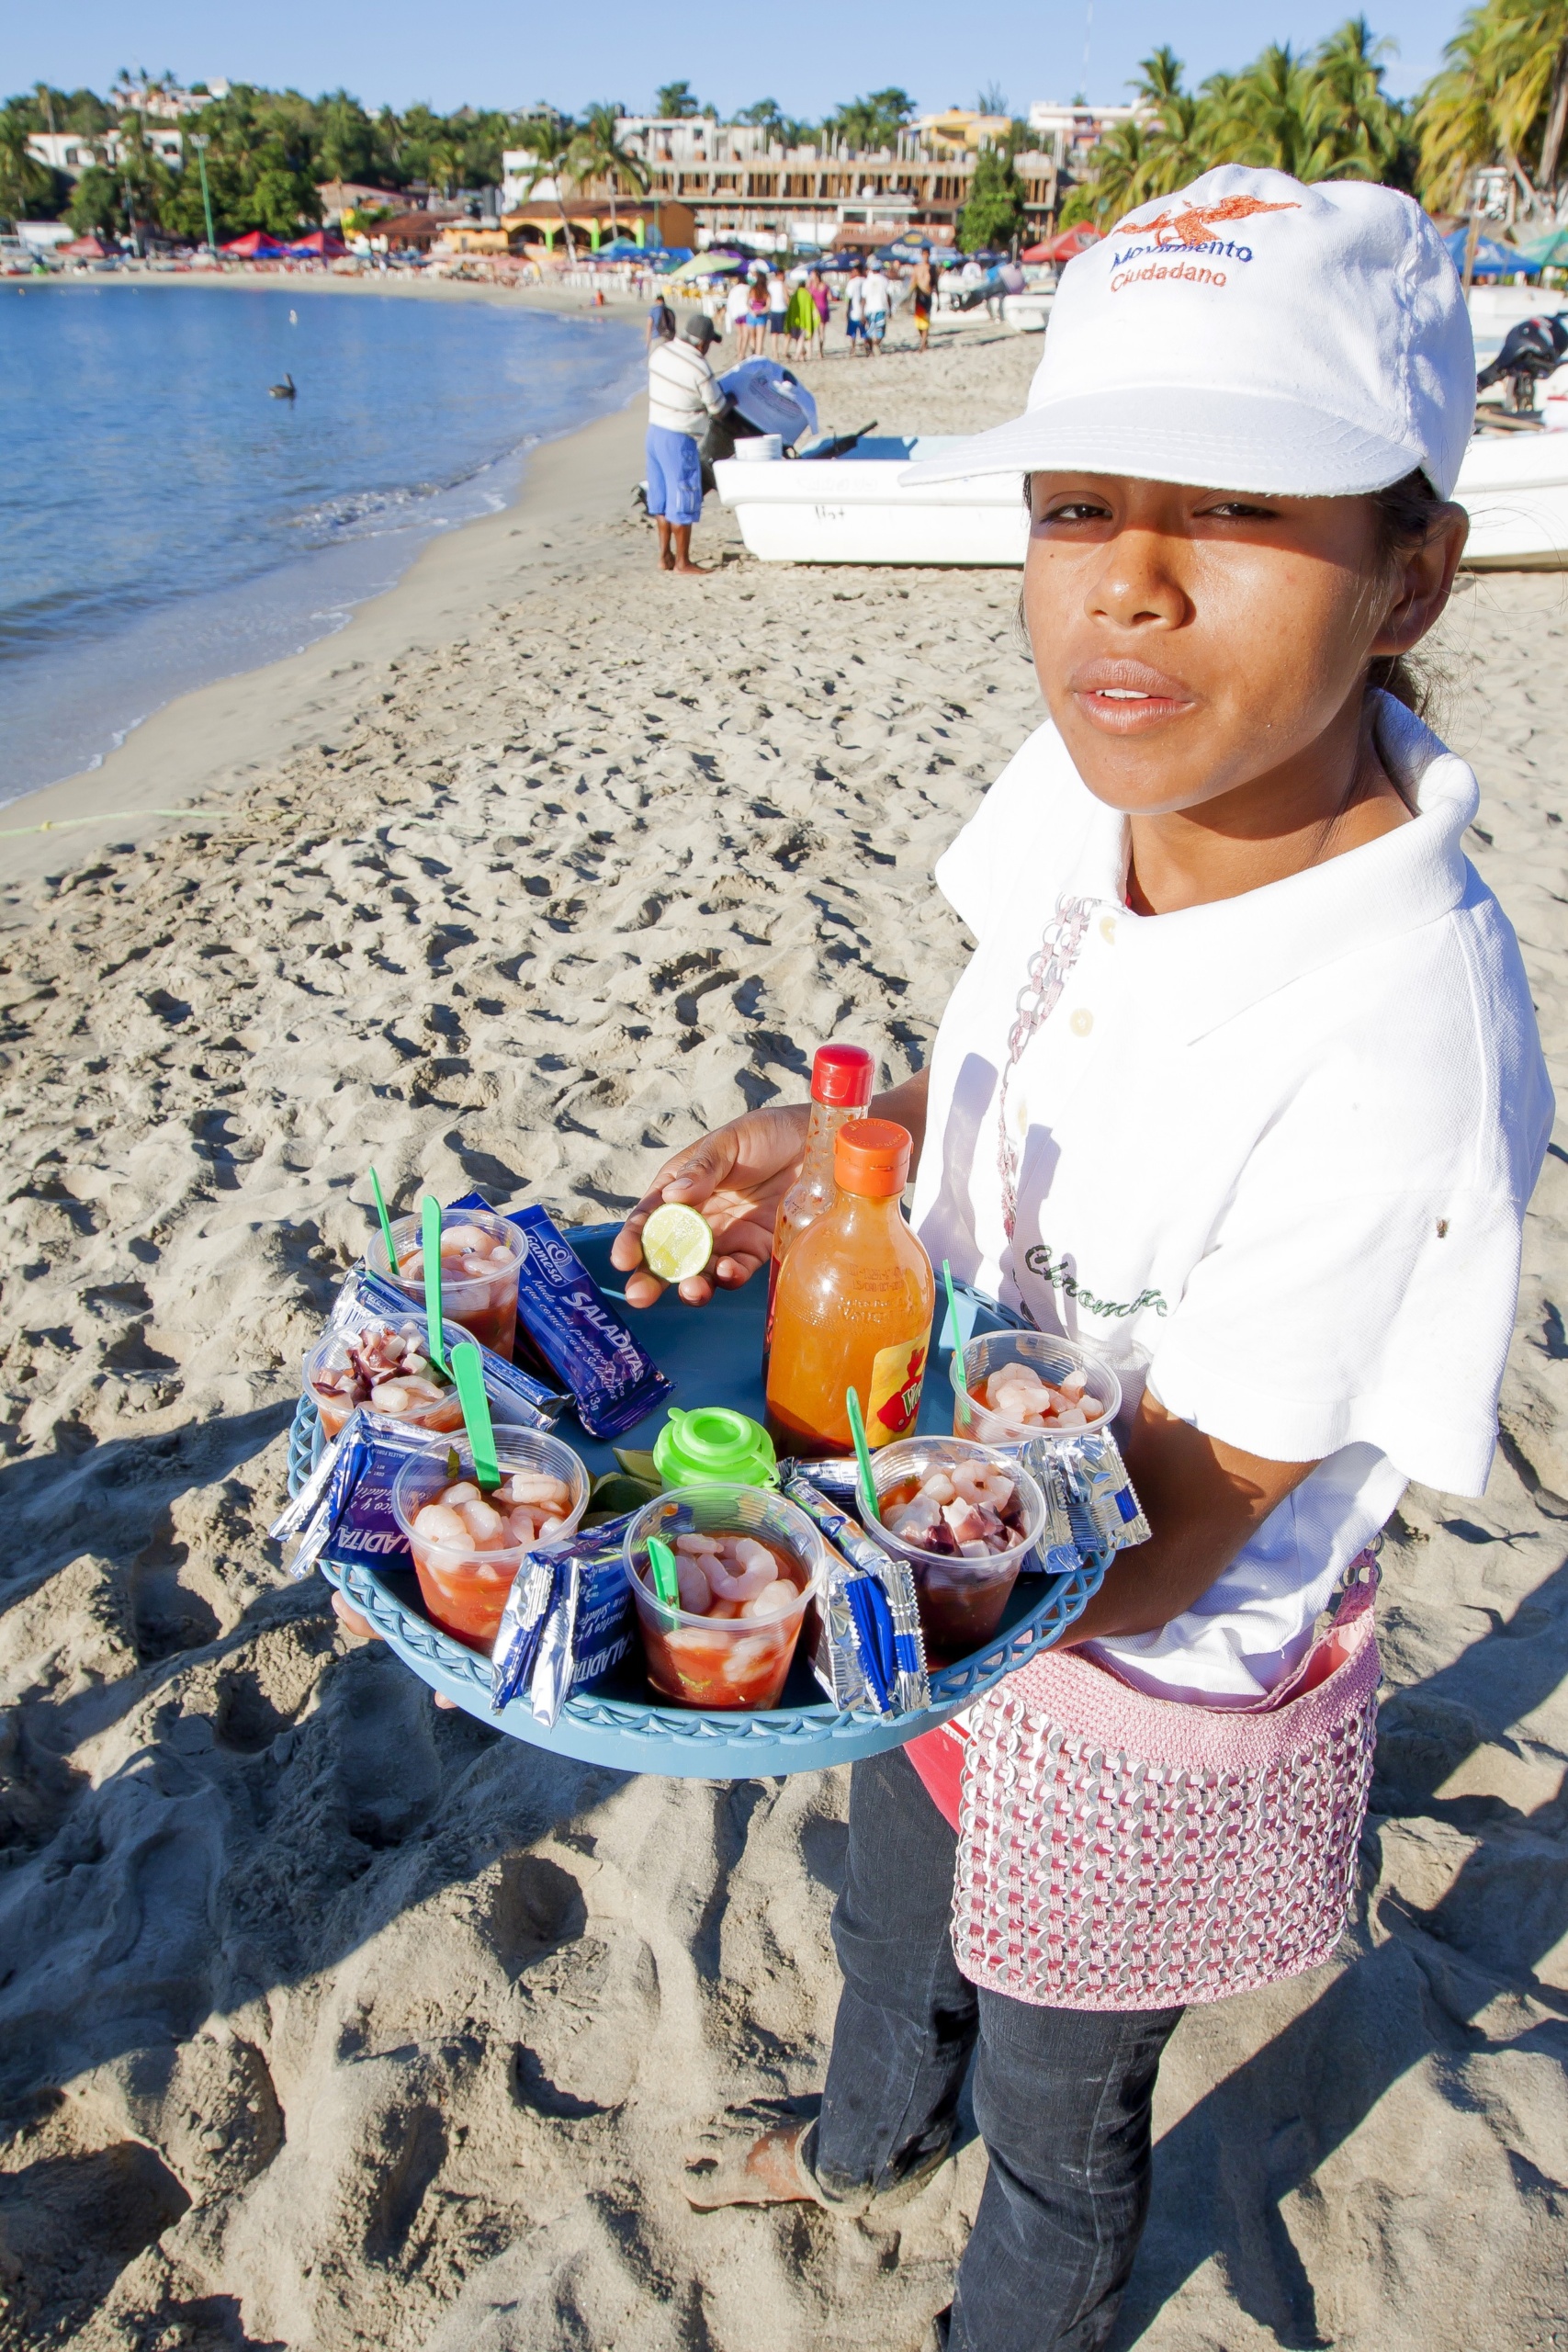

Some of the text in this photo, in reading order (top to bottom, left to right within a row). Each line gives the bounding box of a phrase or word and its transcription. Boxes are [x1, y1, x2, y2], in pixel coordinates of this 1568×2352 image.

[1110, 239, 1254, 274] Movimiento
[1111, 262, 1227, 293] Ciudadano
[526, 1235, 563, 1283] Gamesa
[532, 1280, 556, 1303] Nada
[521, 1285, 541, 1302] que
[565, 1334, 583, 1353] con
[559, 1291, 645, 1384] SALADITAS
